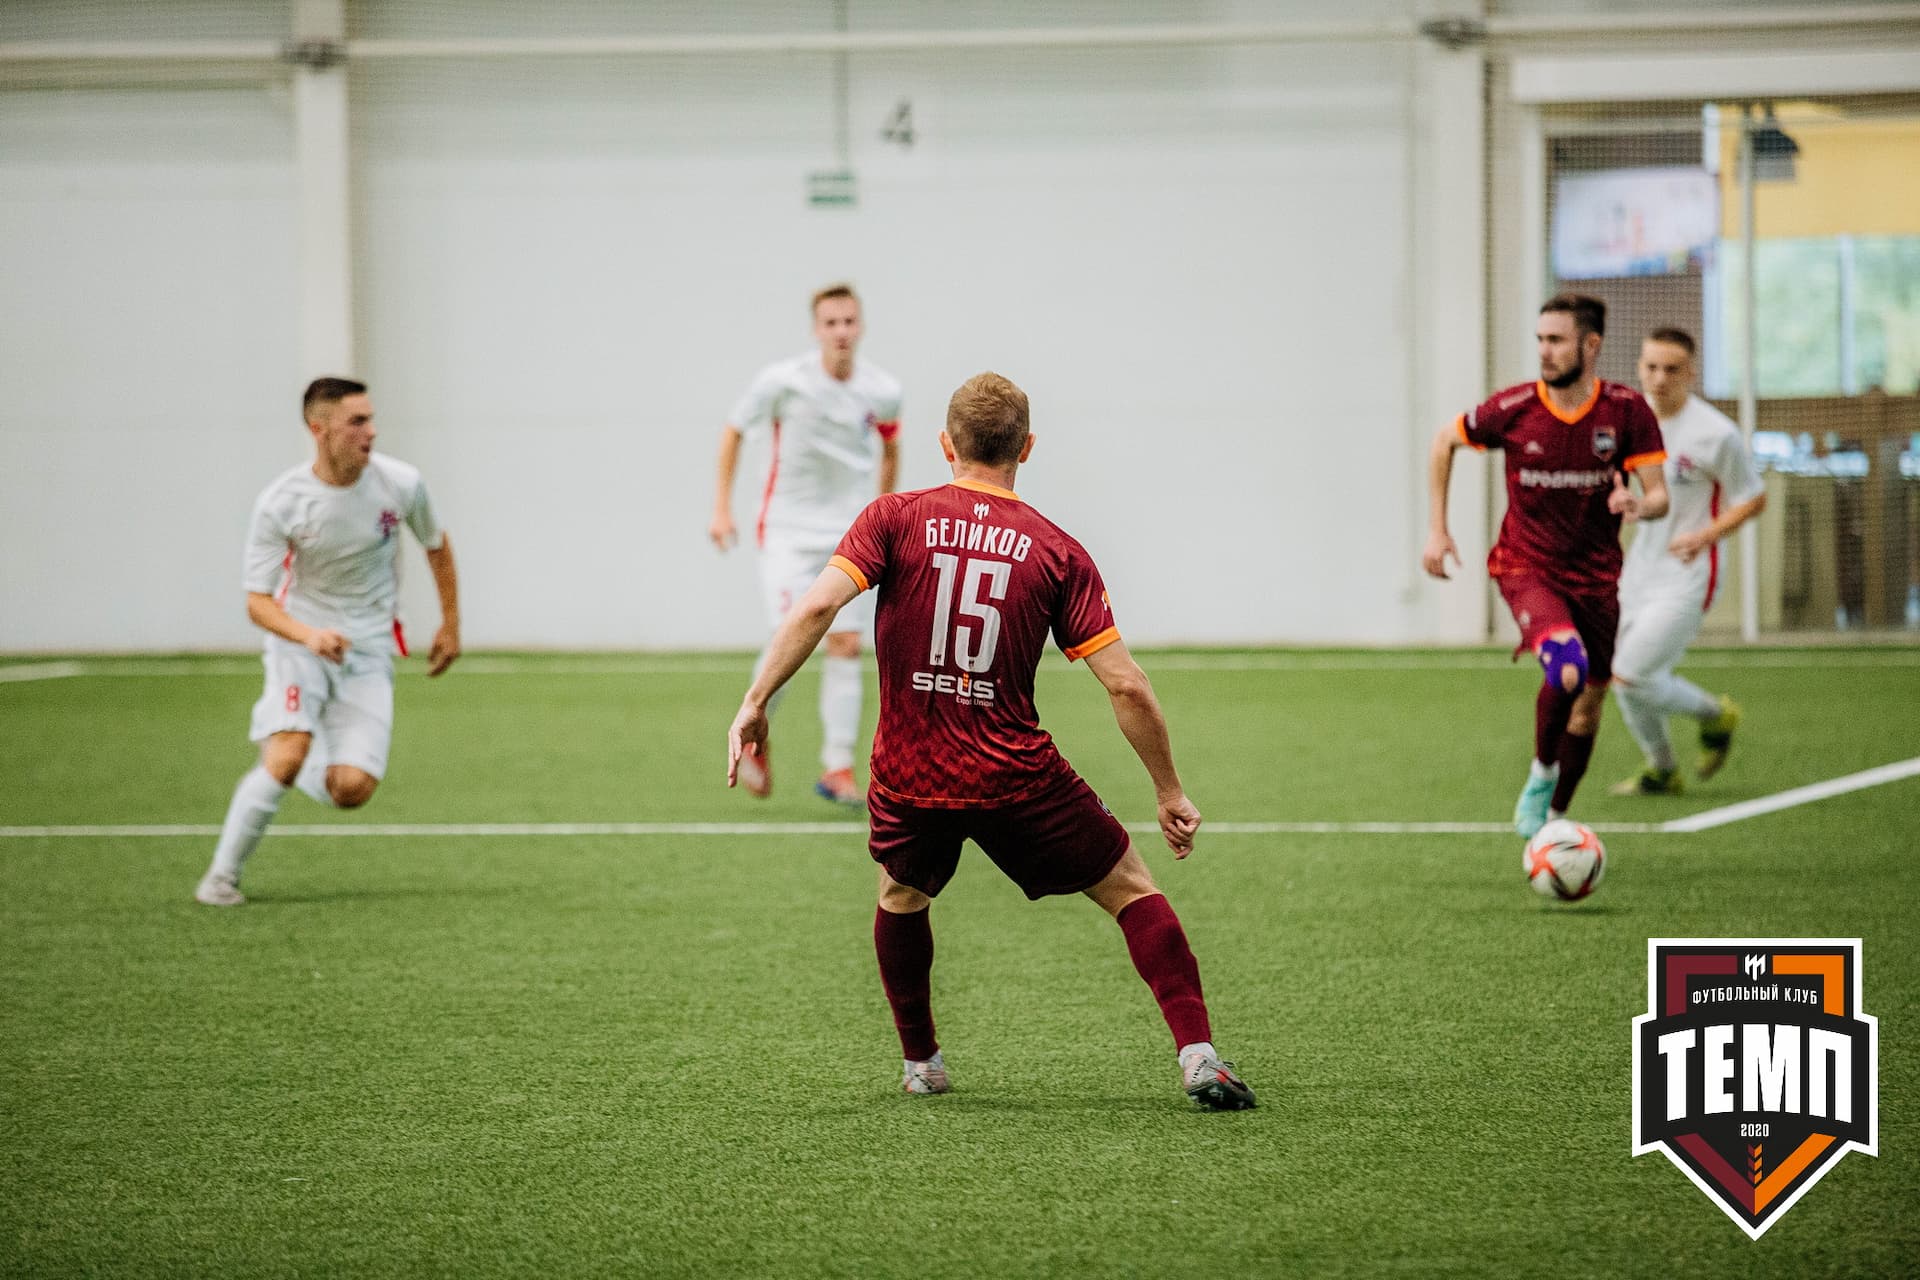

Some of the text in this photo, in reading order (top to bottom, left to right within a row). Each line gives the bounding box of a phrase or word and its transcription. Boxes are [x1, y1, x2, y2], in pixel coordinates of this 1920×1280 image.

[925, 518, 1033, 563] БЕЛИКОВ
[929, 552, 1012, 673] 15
[286, 685, 301, 712] 8
[973, 697, 994, 708] Union
